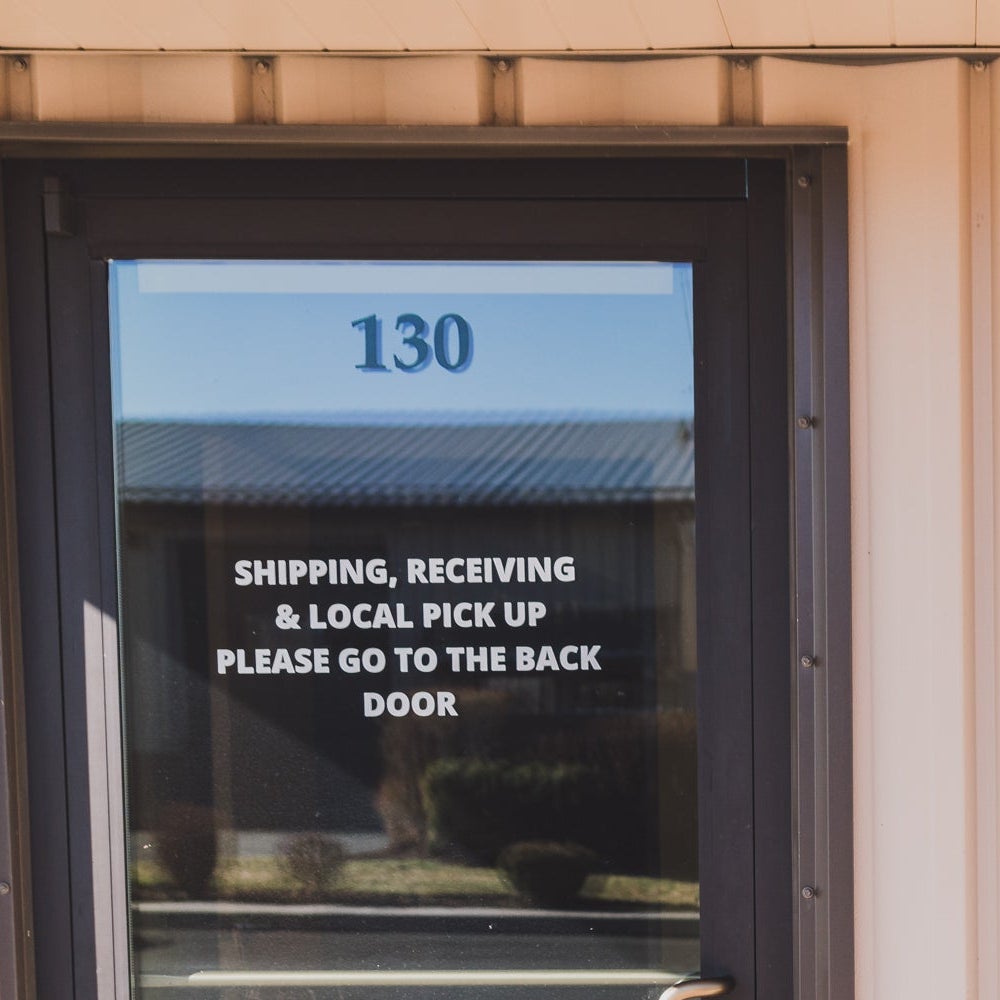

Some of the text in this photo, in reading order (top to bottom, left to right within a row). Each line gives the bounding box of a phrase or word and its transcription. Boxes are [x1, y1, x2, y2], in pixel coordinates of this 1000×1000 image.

[350, 312, 474, 373] 130
[233, 556, 577, 588] SHIPPING, RECEIVING
[274, 601, 547, 630] & LOCAL PICK UP
[216, 645, 602, 674] PLEASE GO TO THE BACK
[363, 691, 458, 717] DOOR
